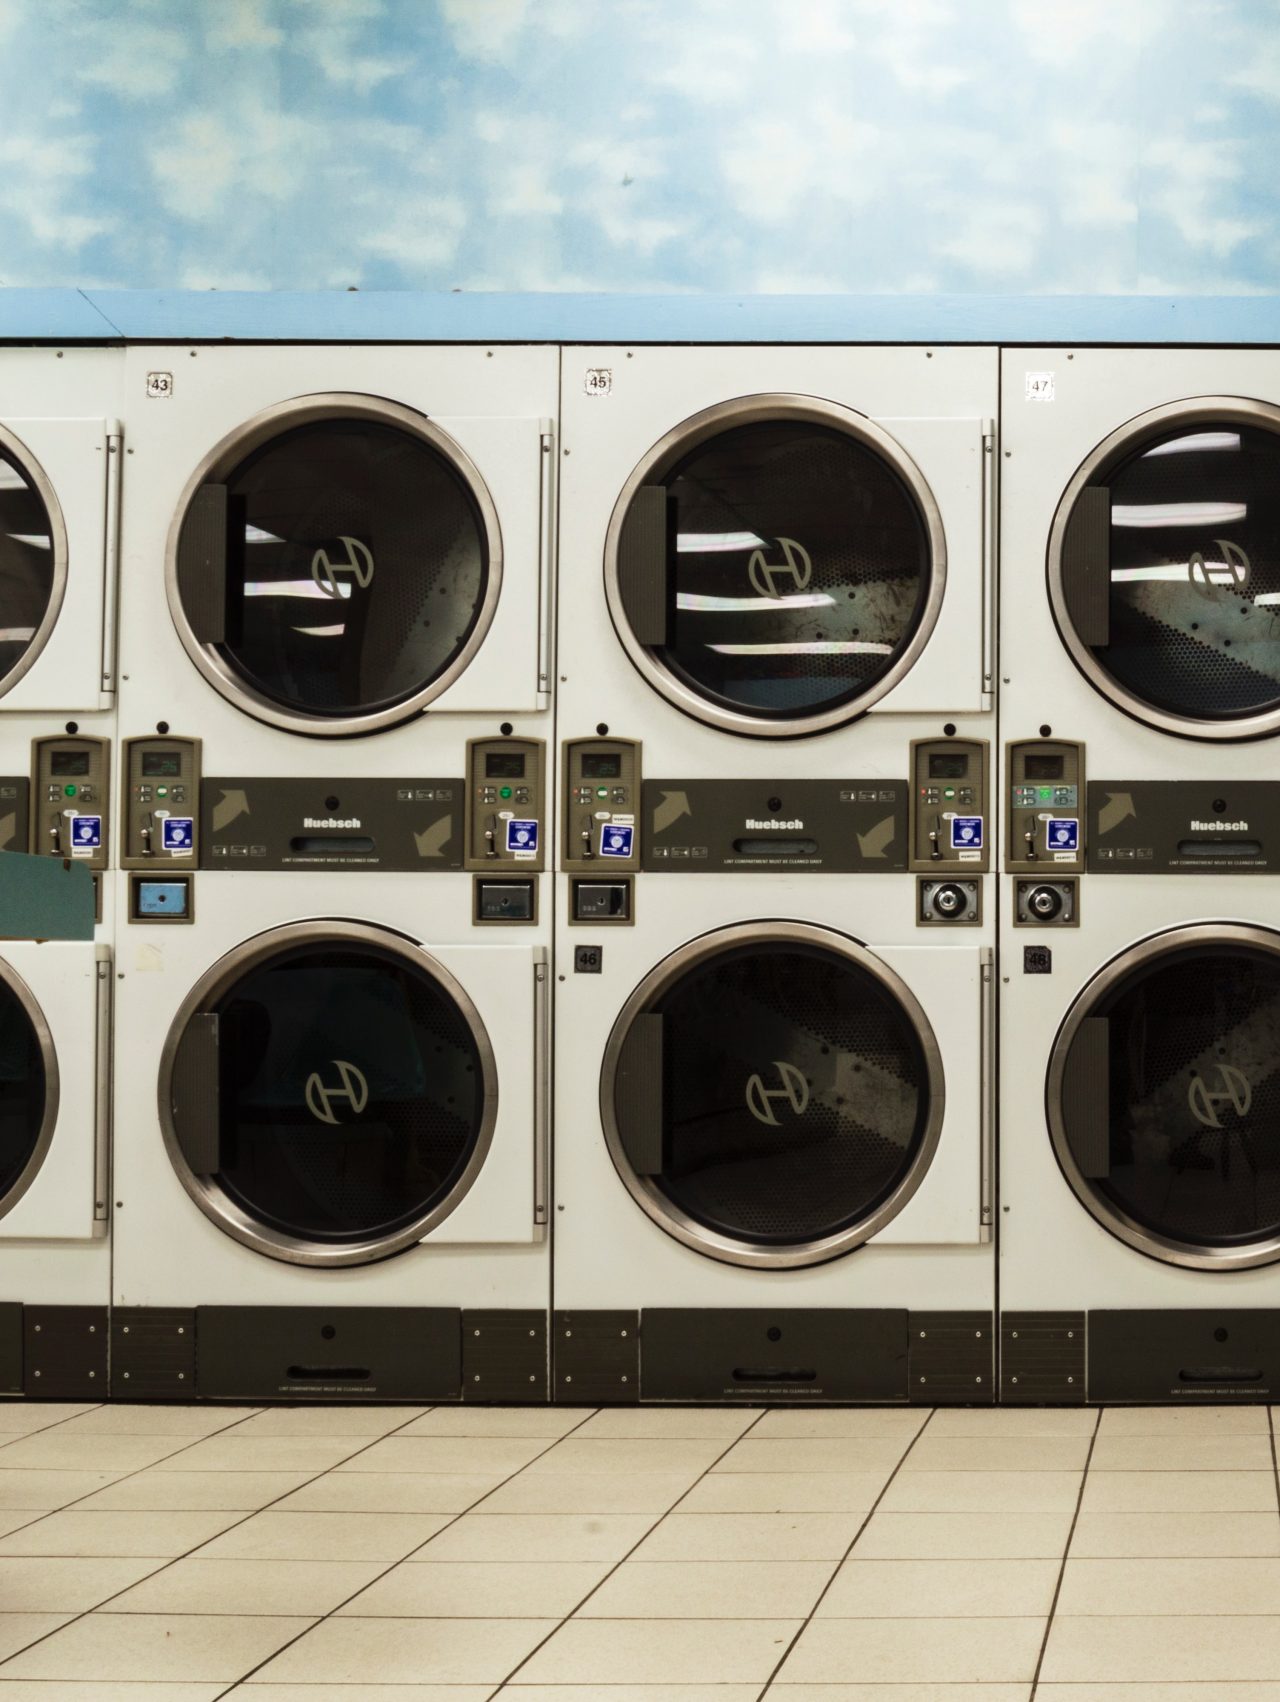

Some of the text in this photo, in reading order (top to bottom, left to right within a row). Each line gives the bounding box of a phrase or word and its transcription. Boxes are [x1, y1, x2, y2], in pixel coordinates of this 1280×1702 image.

[151, 379, 168, 391] 43
[590, 376, 607, 388] 45
[1032, 380, 1049, 392] 47
[303, 817, 361, 829] Huebsch
[745, 819, 804, 830] Huebsch
[1190, 820, 1249, 831] Huebsch
[580, 952, 597, 966] 46
